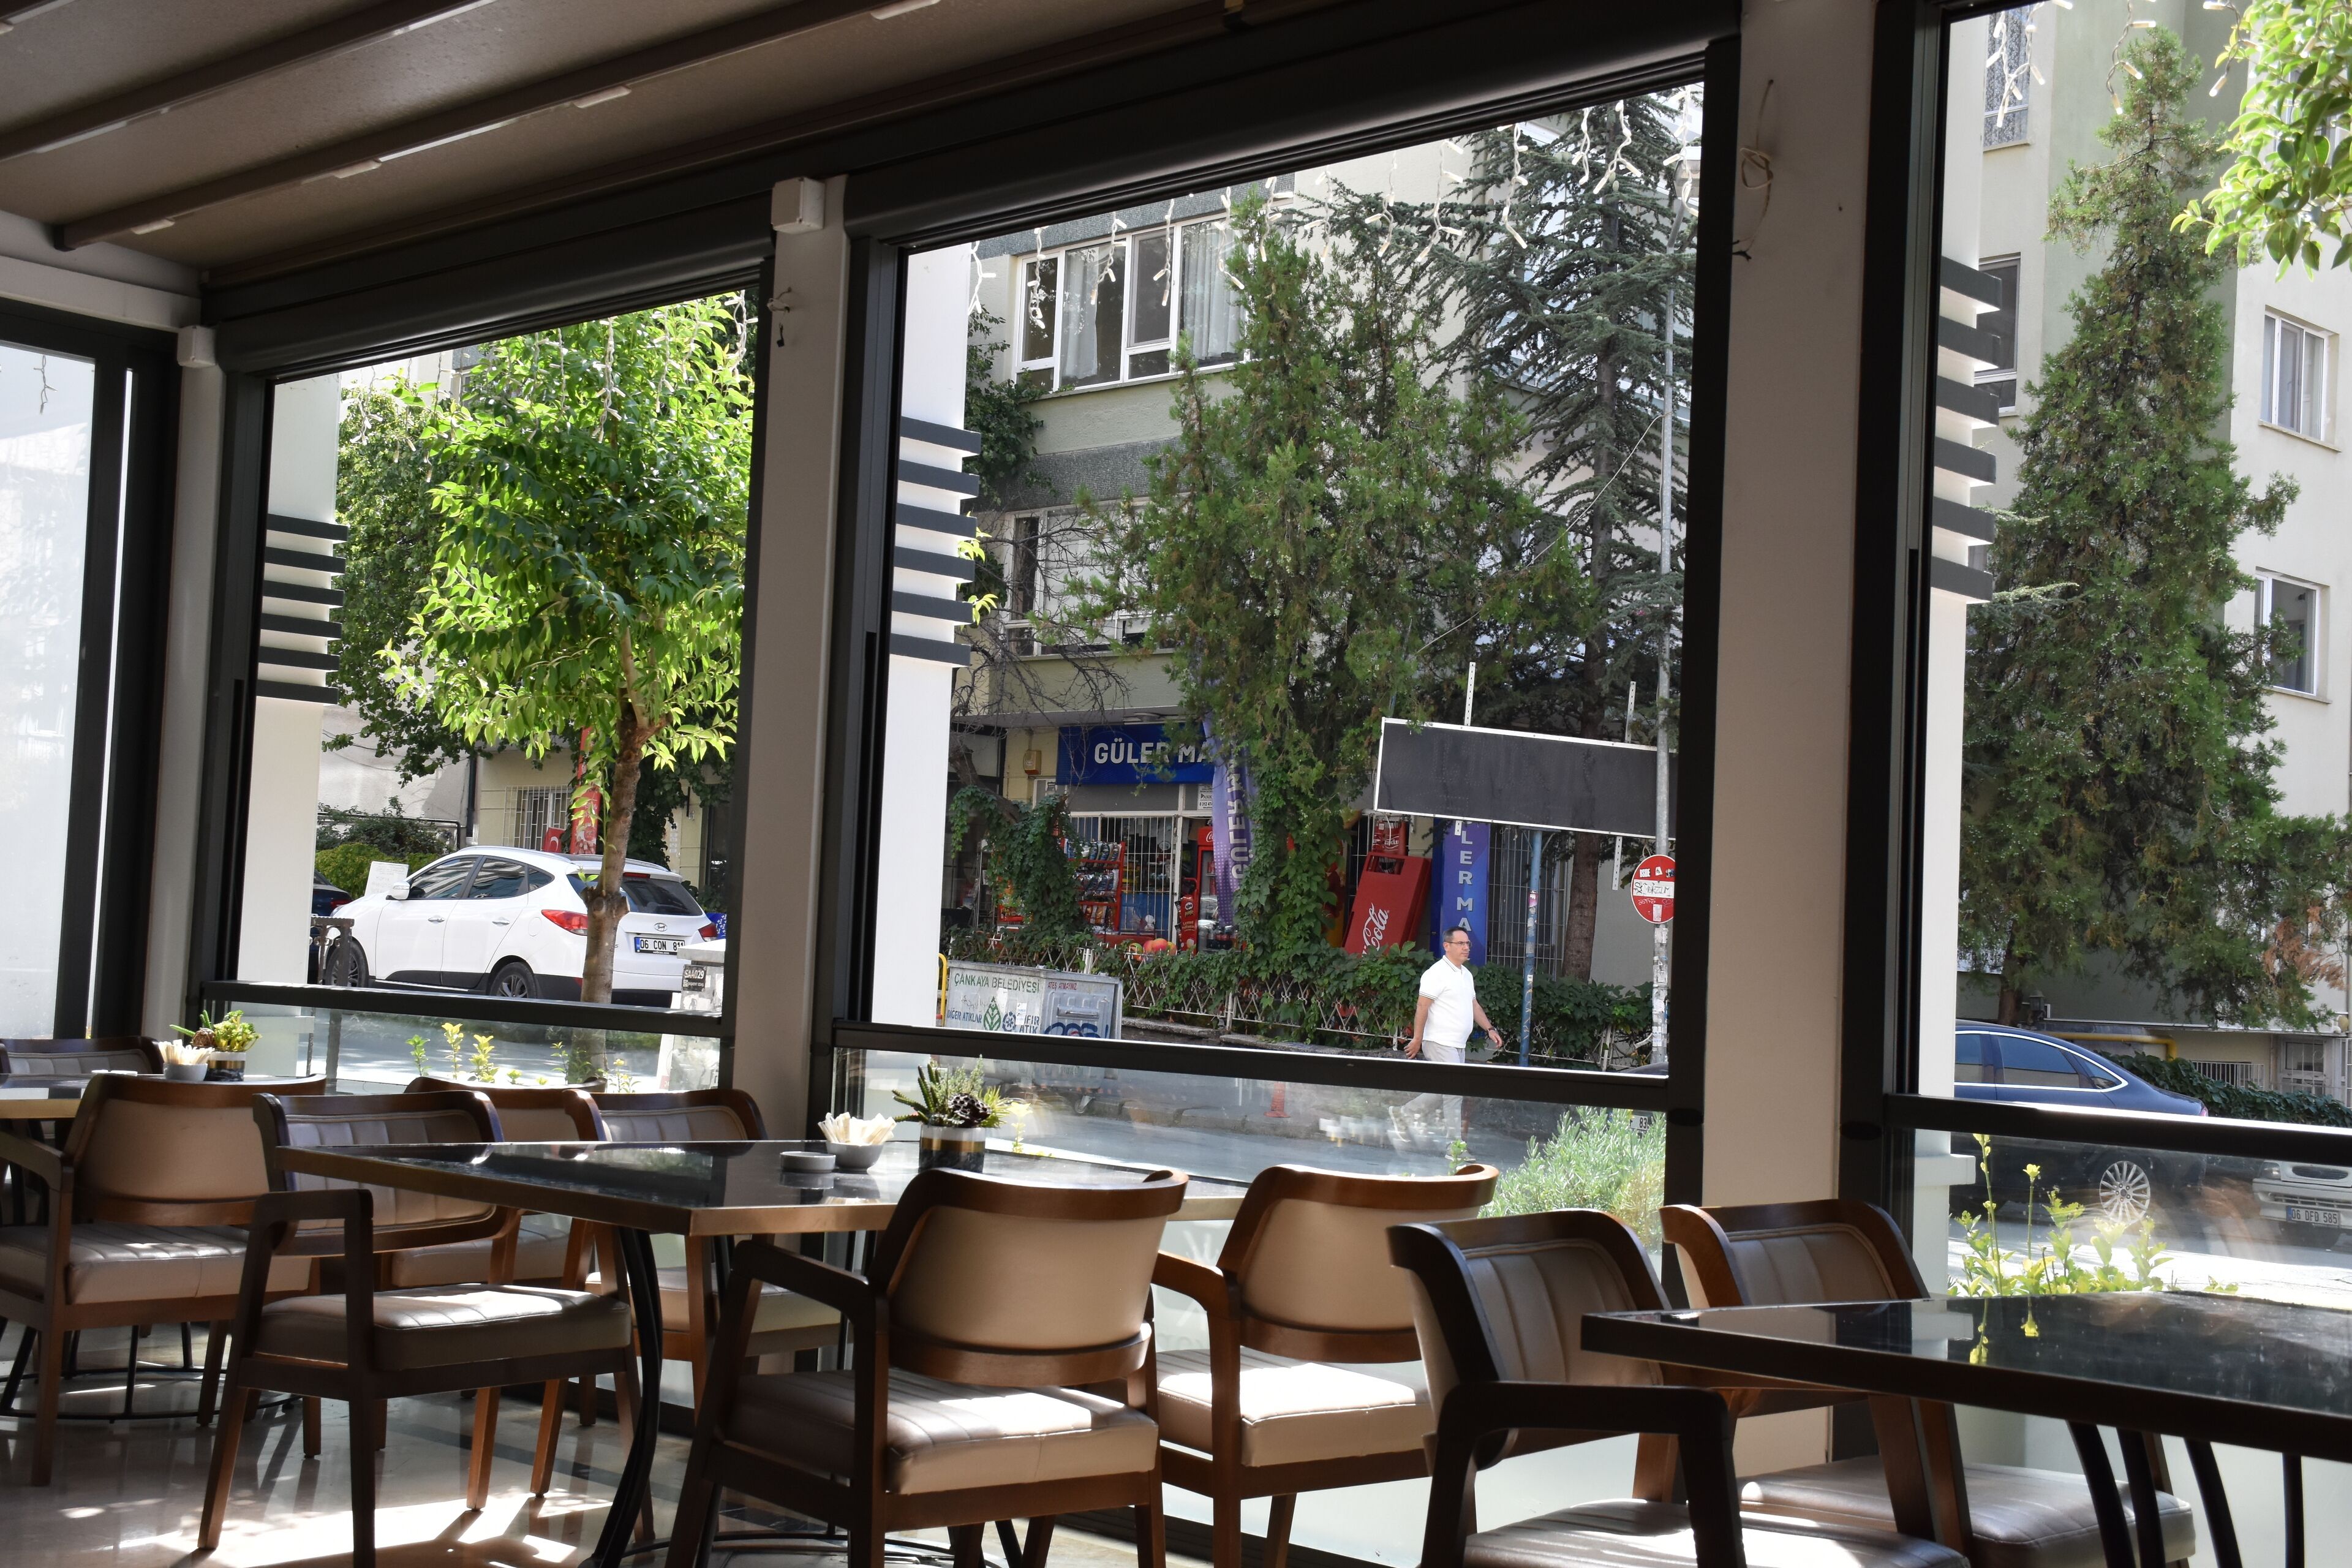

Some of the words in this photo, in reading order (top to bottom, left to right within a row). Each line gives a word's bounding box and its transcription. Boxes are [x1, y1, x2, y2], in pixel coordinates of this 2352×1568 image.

[1095, 737, 1170, 764] GÜLER
[1458, 821, 1473, 884] LER
[640, 940, 649, 949] 06
[654, 940, 666, 950] CON
[684, 969, 704, 979] SAA029
[955, 973, 989, 987] ÇANKAYA
[992, 976, 1039, 993] BELEDİYESİ
[962, 1012, 982, 1023] ATIKLAR
[1024, 1015, 1039, 1025] IFIR
[2293, 1209, 2301, 1219] 06
[2323, 1212, 2337, 1224] 585
